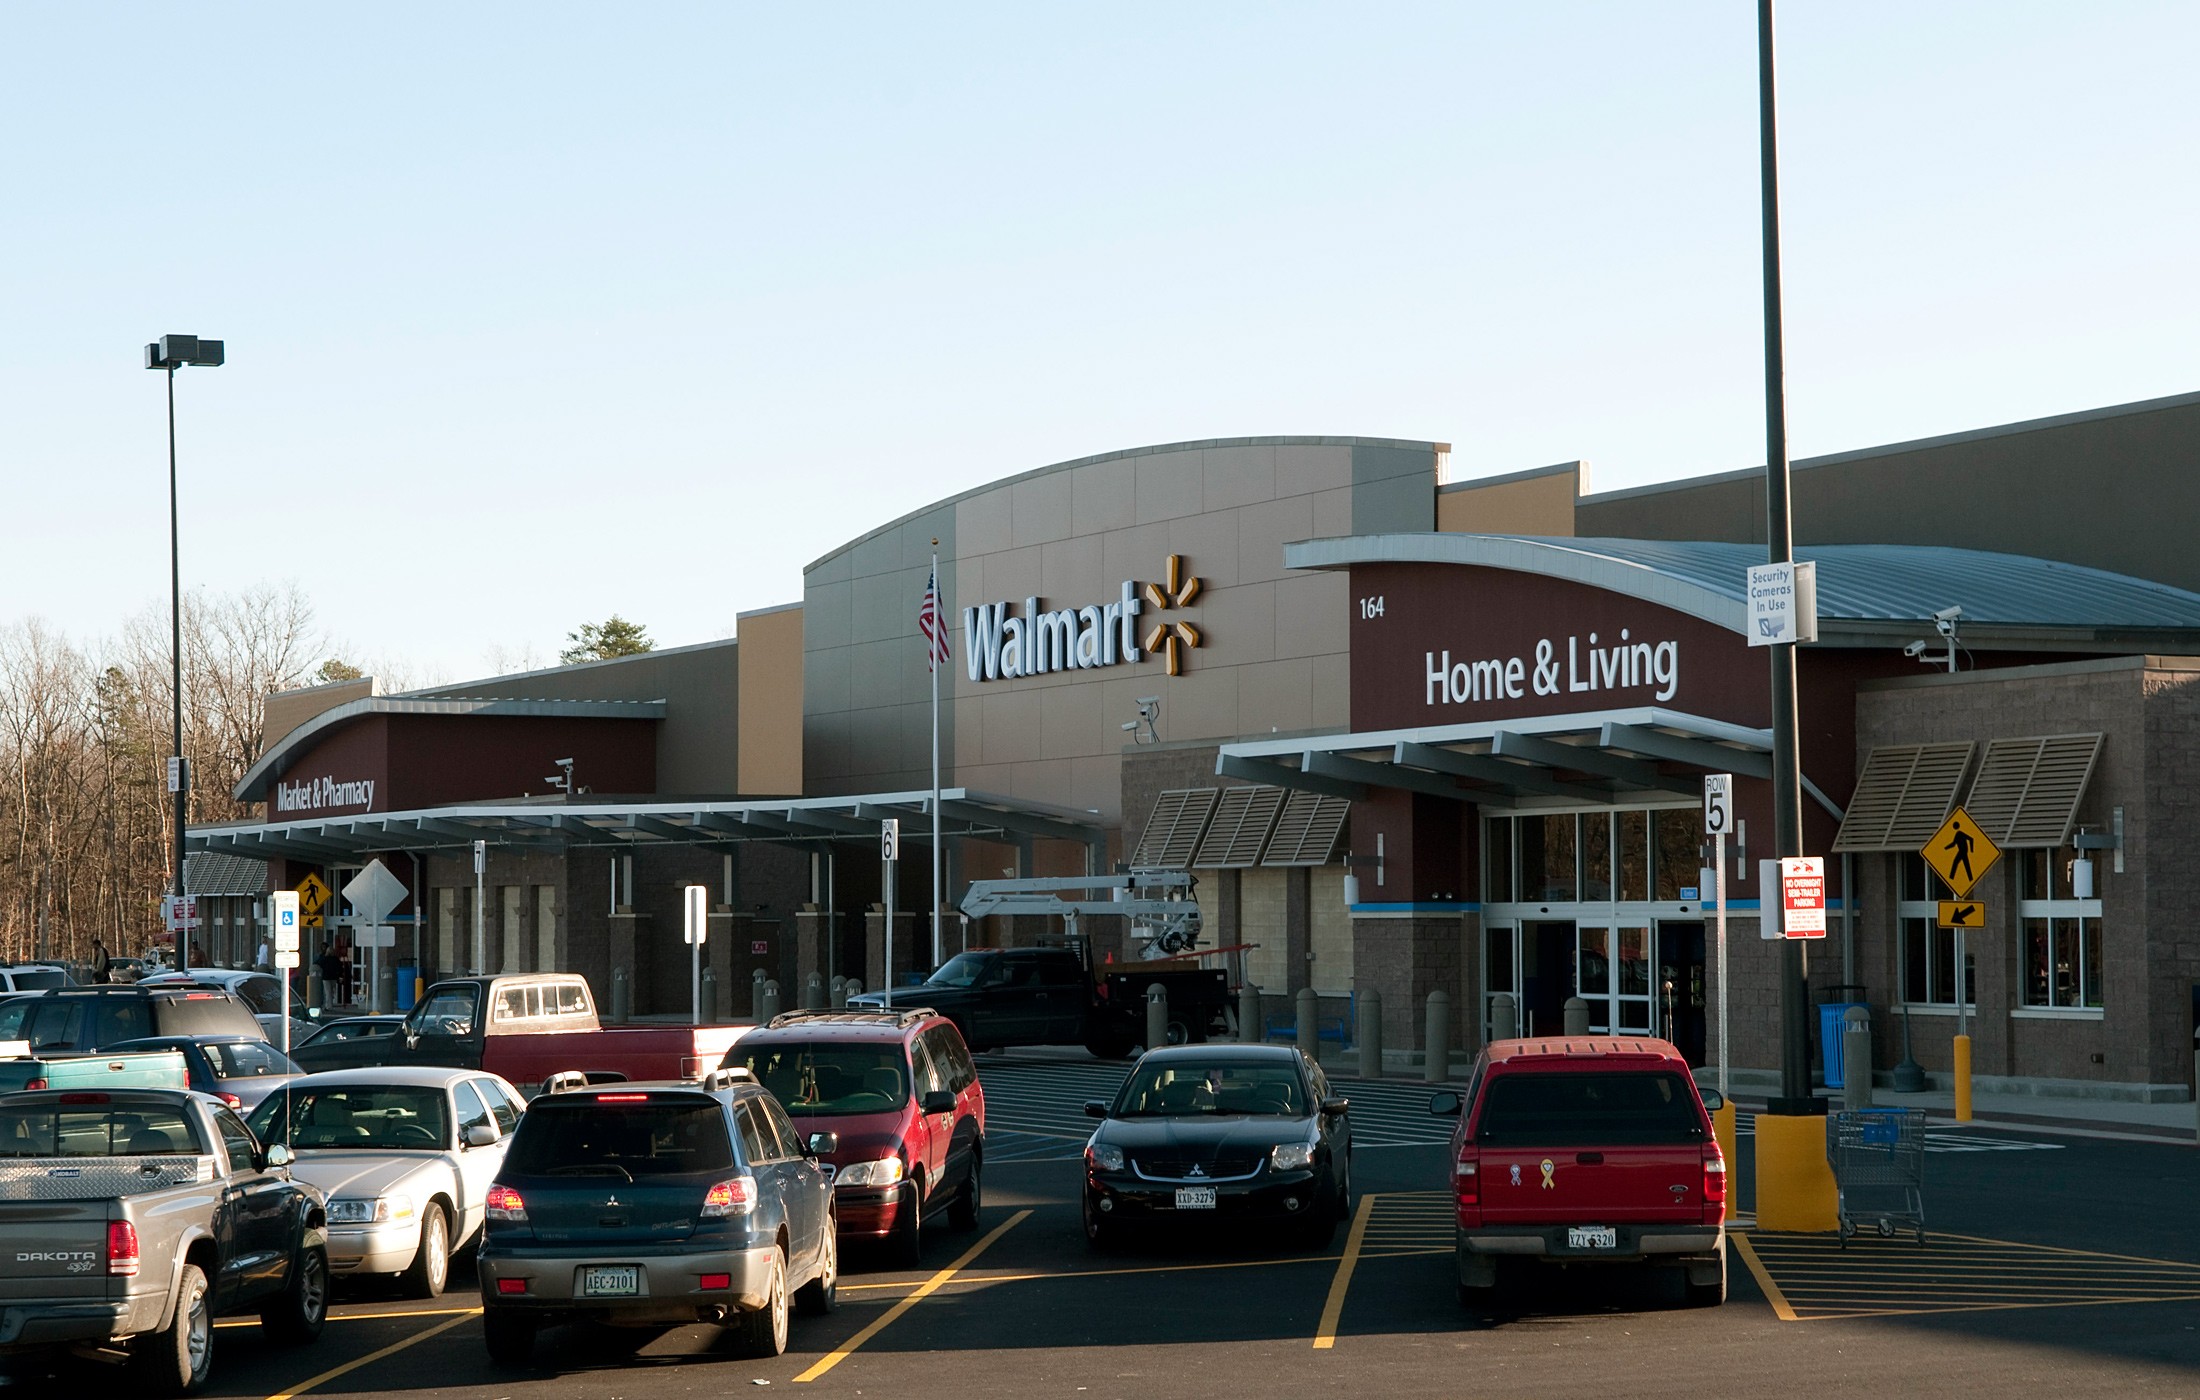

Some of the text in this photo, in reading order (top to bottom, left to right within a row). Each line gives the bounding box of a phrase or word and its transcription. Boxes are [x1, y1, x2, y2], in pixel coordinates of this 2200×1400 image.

[1752, 568, 1789, 584] Security
[1751, 585, 1791, 598] Cameras
[1360, 596, 1385, 619] 164
[1756, 599, 1786, 612] In Use
[963, 580, 1142, 682] Walmart
[1426, 628, 1678, 705] Home & Living
[1706, 777, 1726, 792] ROW
[277, 775, 375, 812] Market & Pharmacy
[1708, 792, 1724, 831] 5
[883, 831, 892, 859] 6
[475, 850, 481, 872] 7
[1785, 878, 1821, 888] NO OVERNIGHT
[1787, 888, 1821, 898] SEMI-TRAILER
[1793, 898, 1816, 907] PARKING
[1177, 1193, 1214, 1204] XXD-3279
[16, 1252, 96, 1261] DAKOTA
[587, 1275, 633, 1289] AEC-2101
